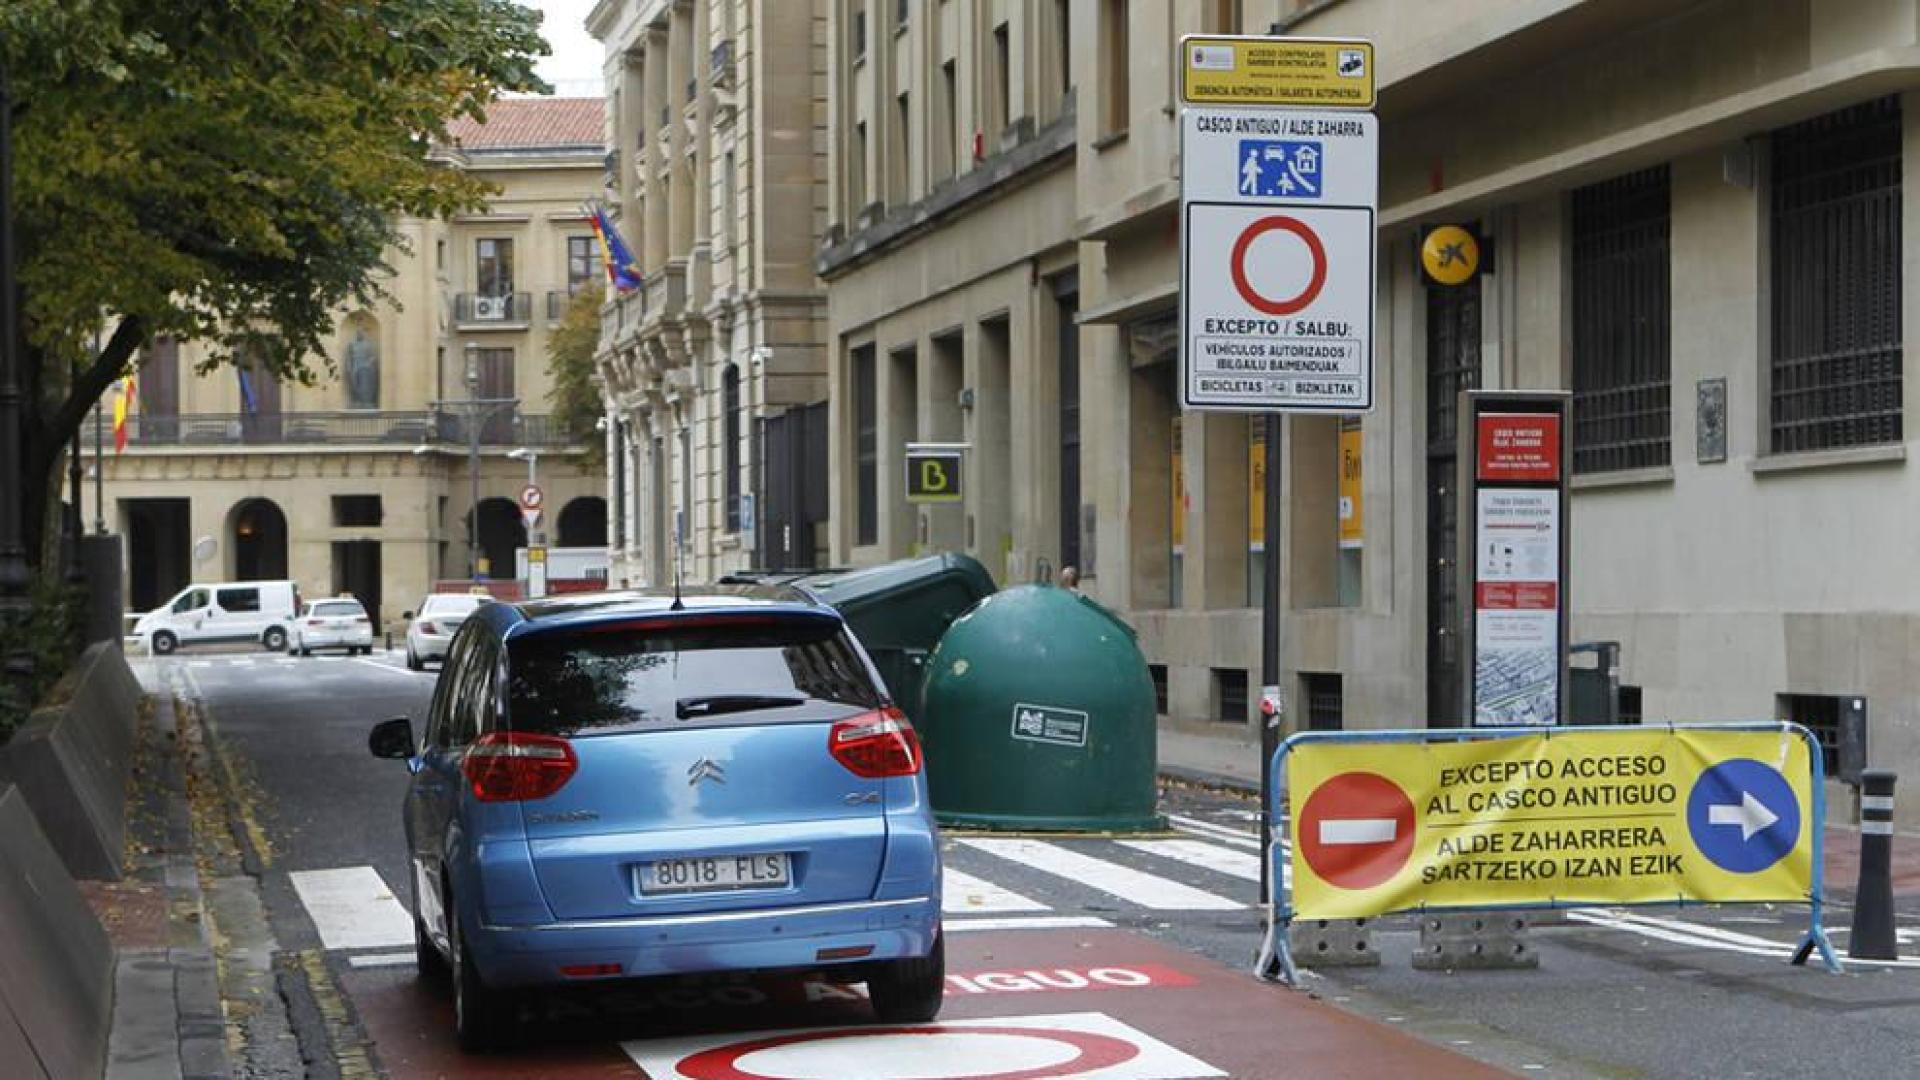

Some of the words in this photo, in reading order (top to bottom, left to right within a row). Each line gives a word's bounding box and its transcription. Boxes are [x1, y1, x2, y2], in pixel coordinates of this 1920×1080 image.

[1197, 116, 1232, 132] CASCO
[1236, 117, 1280, 134] ANTIGUO
[1290, 119, 1314, 136] ALDE
[1318, 120, 1364, 137] ZAHARRA
[1205, 319, 1279, 334] EXCEPTO
[1295, 322, 1353, 336] SALBU:
[1217, 358, 1267, 371] IBILGAILU
[1269, 360, 1339, 372] BAIMENDUAK
[1269, 345, 1345, 358] AUTORIZADOS
[1201, 380, 1264, 392] BICICLETAS
[1295, 383, 1355, 394] BIZIKLETAK
[922, 460, 947, 491] B
[1440, 760, 1553, 788] EXCEPTO
[1560, 756, 1666, 779] ACCESO
[1427, 795, 1459, 815] AL
[1468, 788, 1556, 812] CASCO
[1563, 783, 1677, 807] ANTIGUO
[1437, 832, 1504, 856] ALDE
[1511, 826, 1667, 852] ZAHARRERA
[658, 859, 717, 885] 8018
[736, 855, 780, 881] FLS
[1422, 857, 1556, 884] SARTZEKO
[1565, 857, 1622, 878] IZAN
[1630, 854, 1684, 875] EZIK
